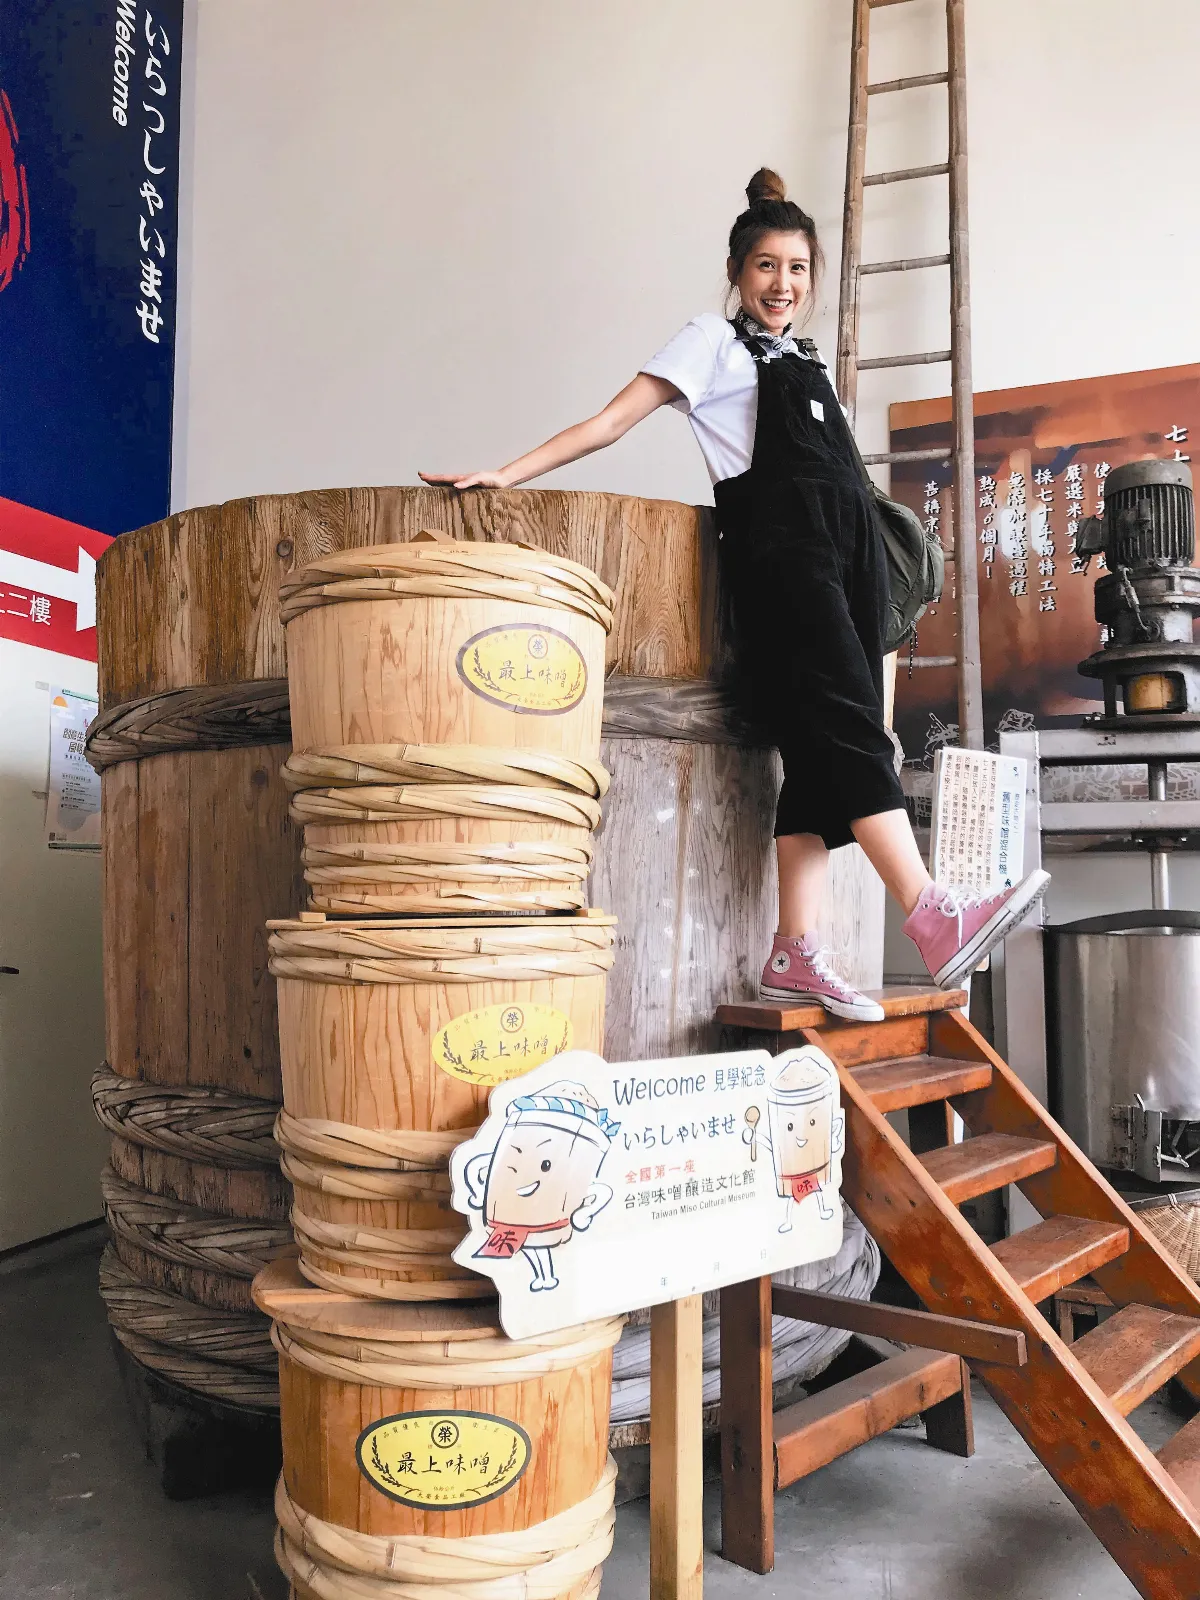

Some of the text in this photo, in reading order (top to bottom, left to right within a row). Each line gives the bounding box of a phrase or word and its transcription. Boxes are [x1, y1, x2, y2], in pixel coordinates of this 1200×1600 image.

[112, 0, 138, 127] Welcome
[136, 9, 170, 343] いらっしゃいませ
[498, 660, 567, 688] 最上味噌
[470, 1034, 549, 1062] 最上味噌
[612, 1064, 766, 1106] Welcome 見學紀念
[623, 1113, 736, 1151] いらしゃいませ
[624, 1159, 697, 1184] 全國第一座
[624, 1168, 756, 1210] 台灣味噌釀造文化館
[651, 1190, 756, 1220] Taiwan Miso Cultural Museum
[488, 1230, 518, 1255] 味
[437, 1425, 453, 1444] 榮
[397, 1451, 490, 1475] 最上味噌
